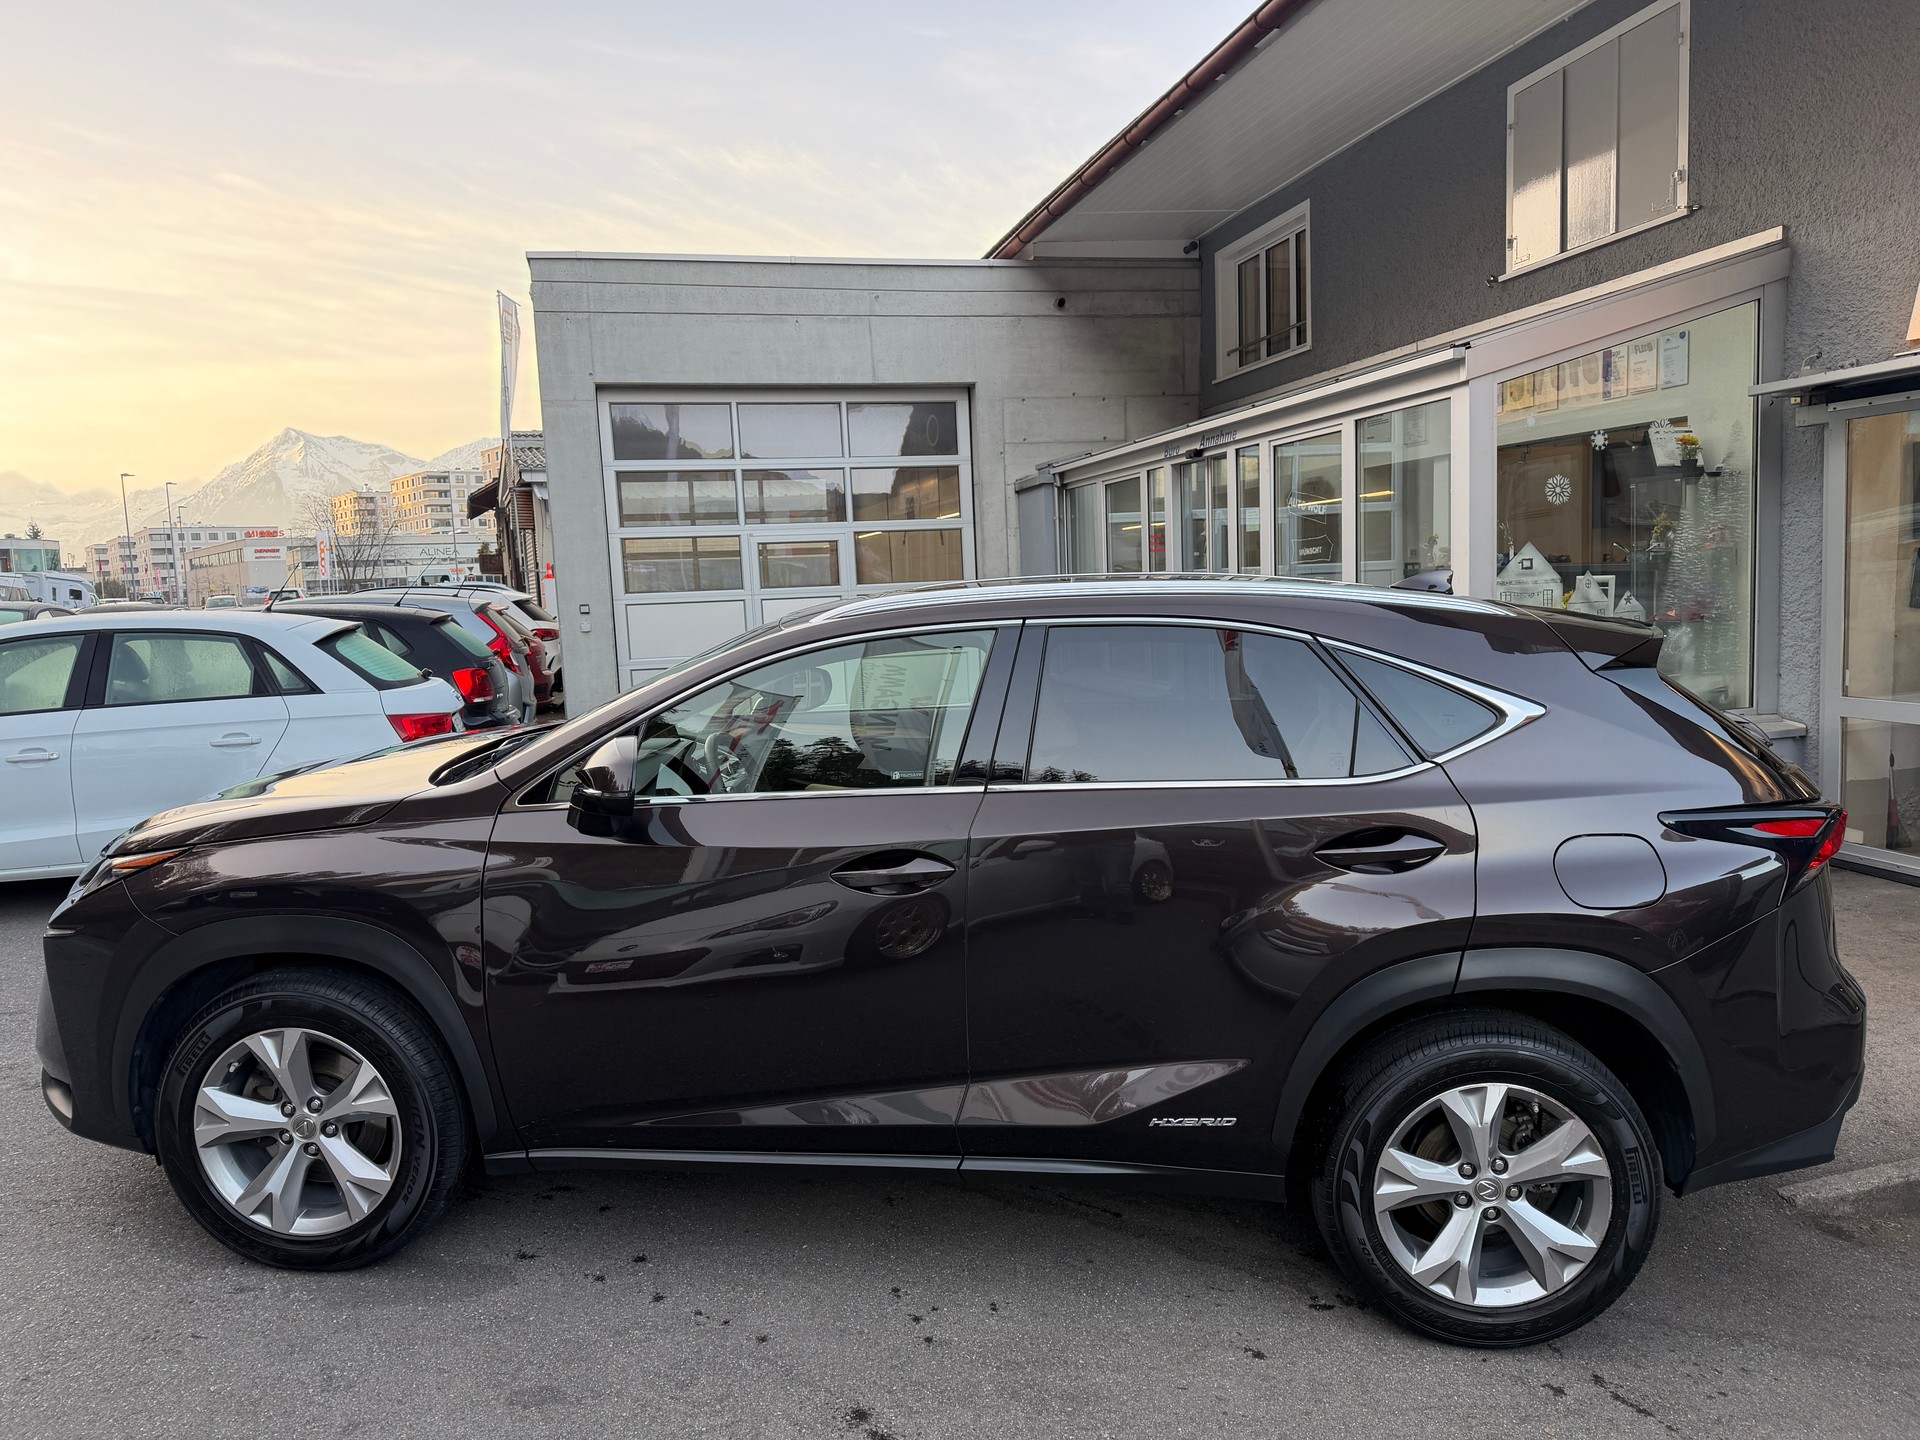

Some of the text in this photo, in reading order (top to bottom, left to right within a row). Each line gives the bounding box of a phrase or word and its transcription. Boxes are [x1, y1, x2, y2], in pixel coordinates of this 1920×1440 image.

[1199, 430, 1237, 448] Annahme
[1164, 444, 1180, 458] Büro
[1288, 496, 1306, 511] AUTO
[420, 548, 460, 556] ALINEA
[175, 1031, 212, 1077] PIRELLI
[1149, 1117, 1237, 1127] HYBRID
[401, 1157, 421, 1206] VERDE
[1624, 1147, 1648, 1205] PIRELLI
